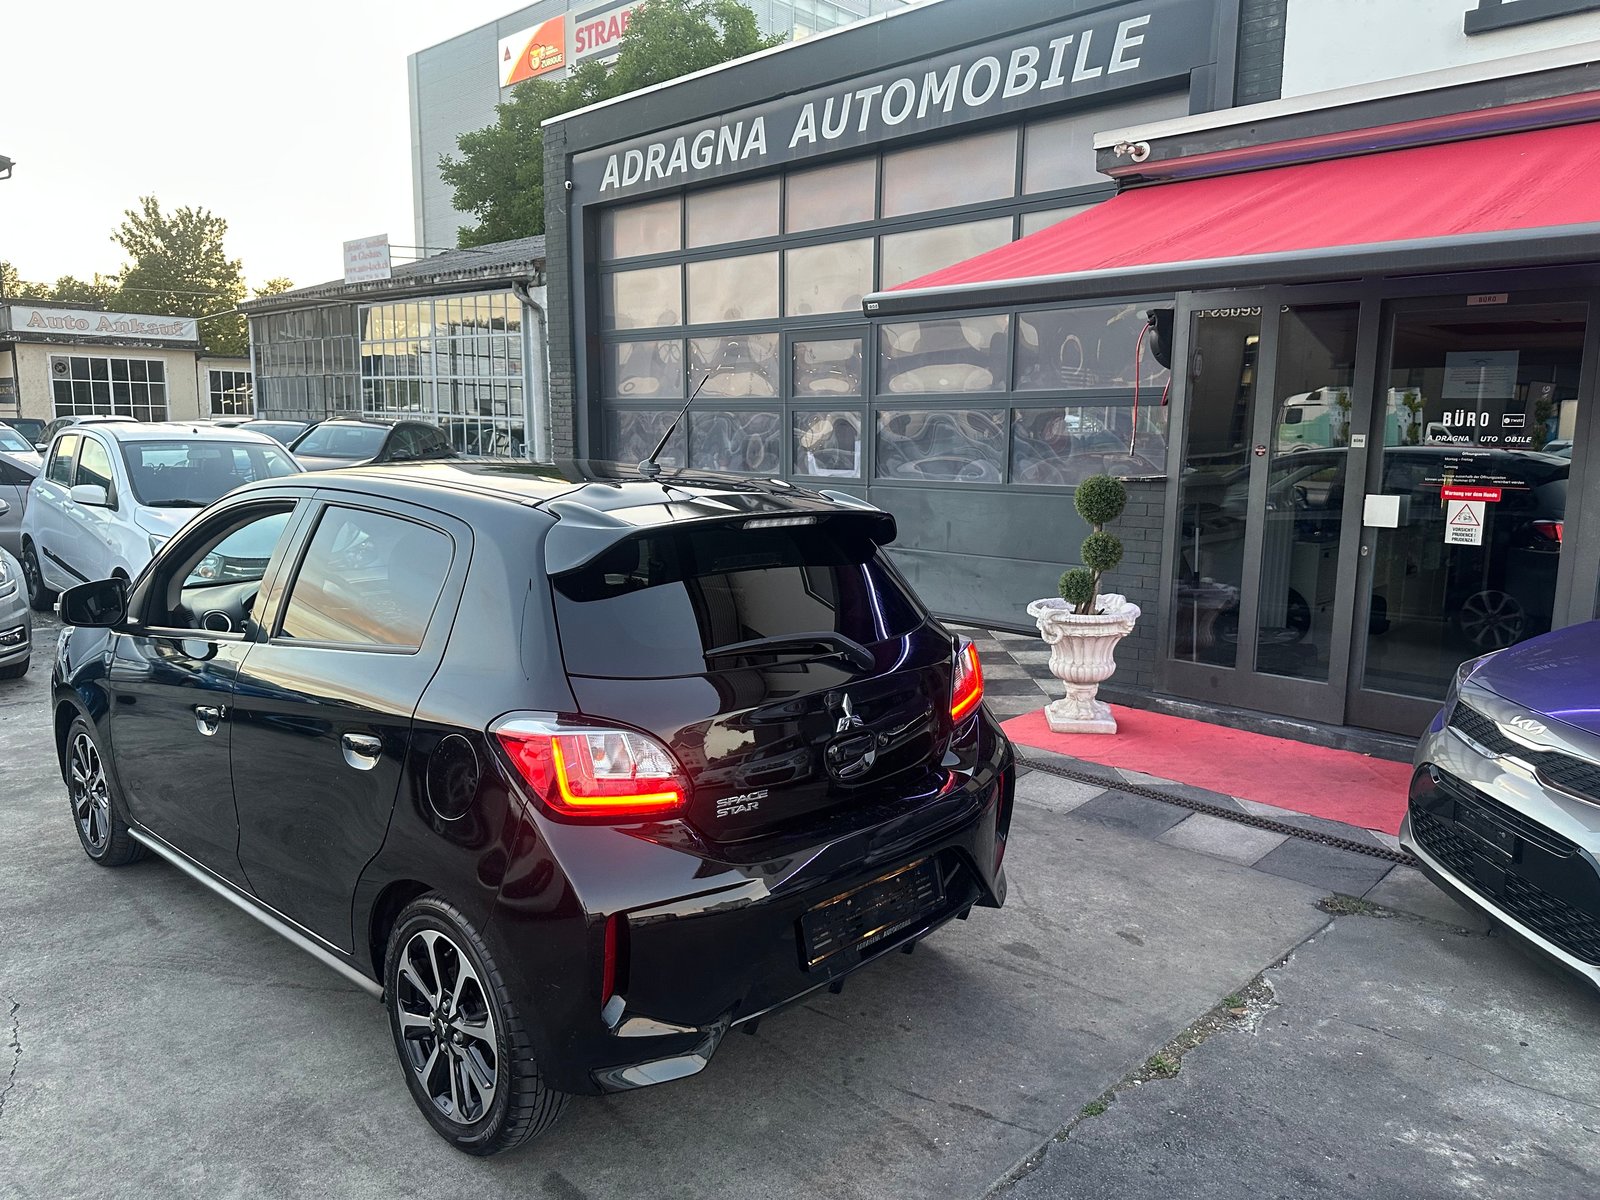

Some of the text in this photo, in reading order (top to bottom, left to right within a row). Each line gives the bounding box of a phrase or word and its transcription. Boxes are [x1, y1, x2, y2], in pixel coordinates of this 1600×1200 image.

[600, 14, 1151, 192] ADRAGNA AUTOMOBILE
[27, 311, 184, 337] Auto Ankauf
[1442, 409, 1490, 427] BÜRO
[716, 789, 769, 808] SPACE
[716, 801, 759, 818] STAR
